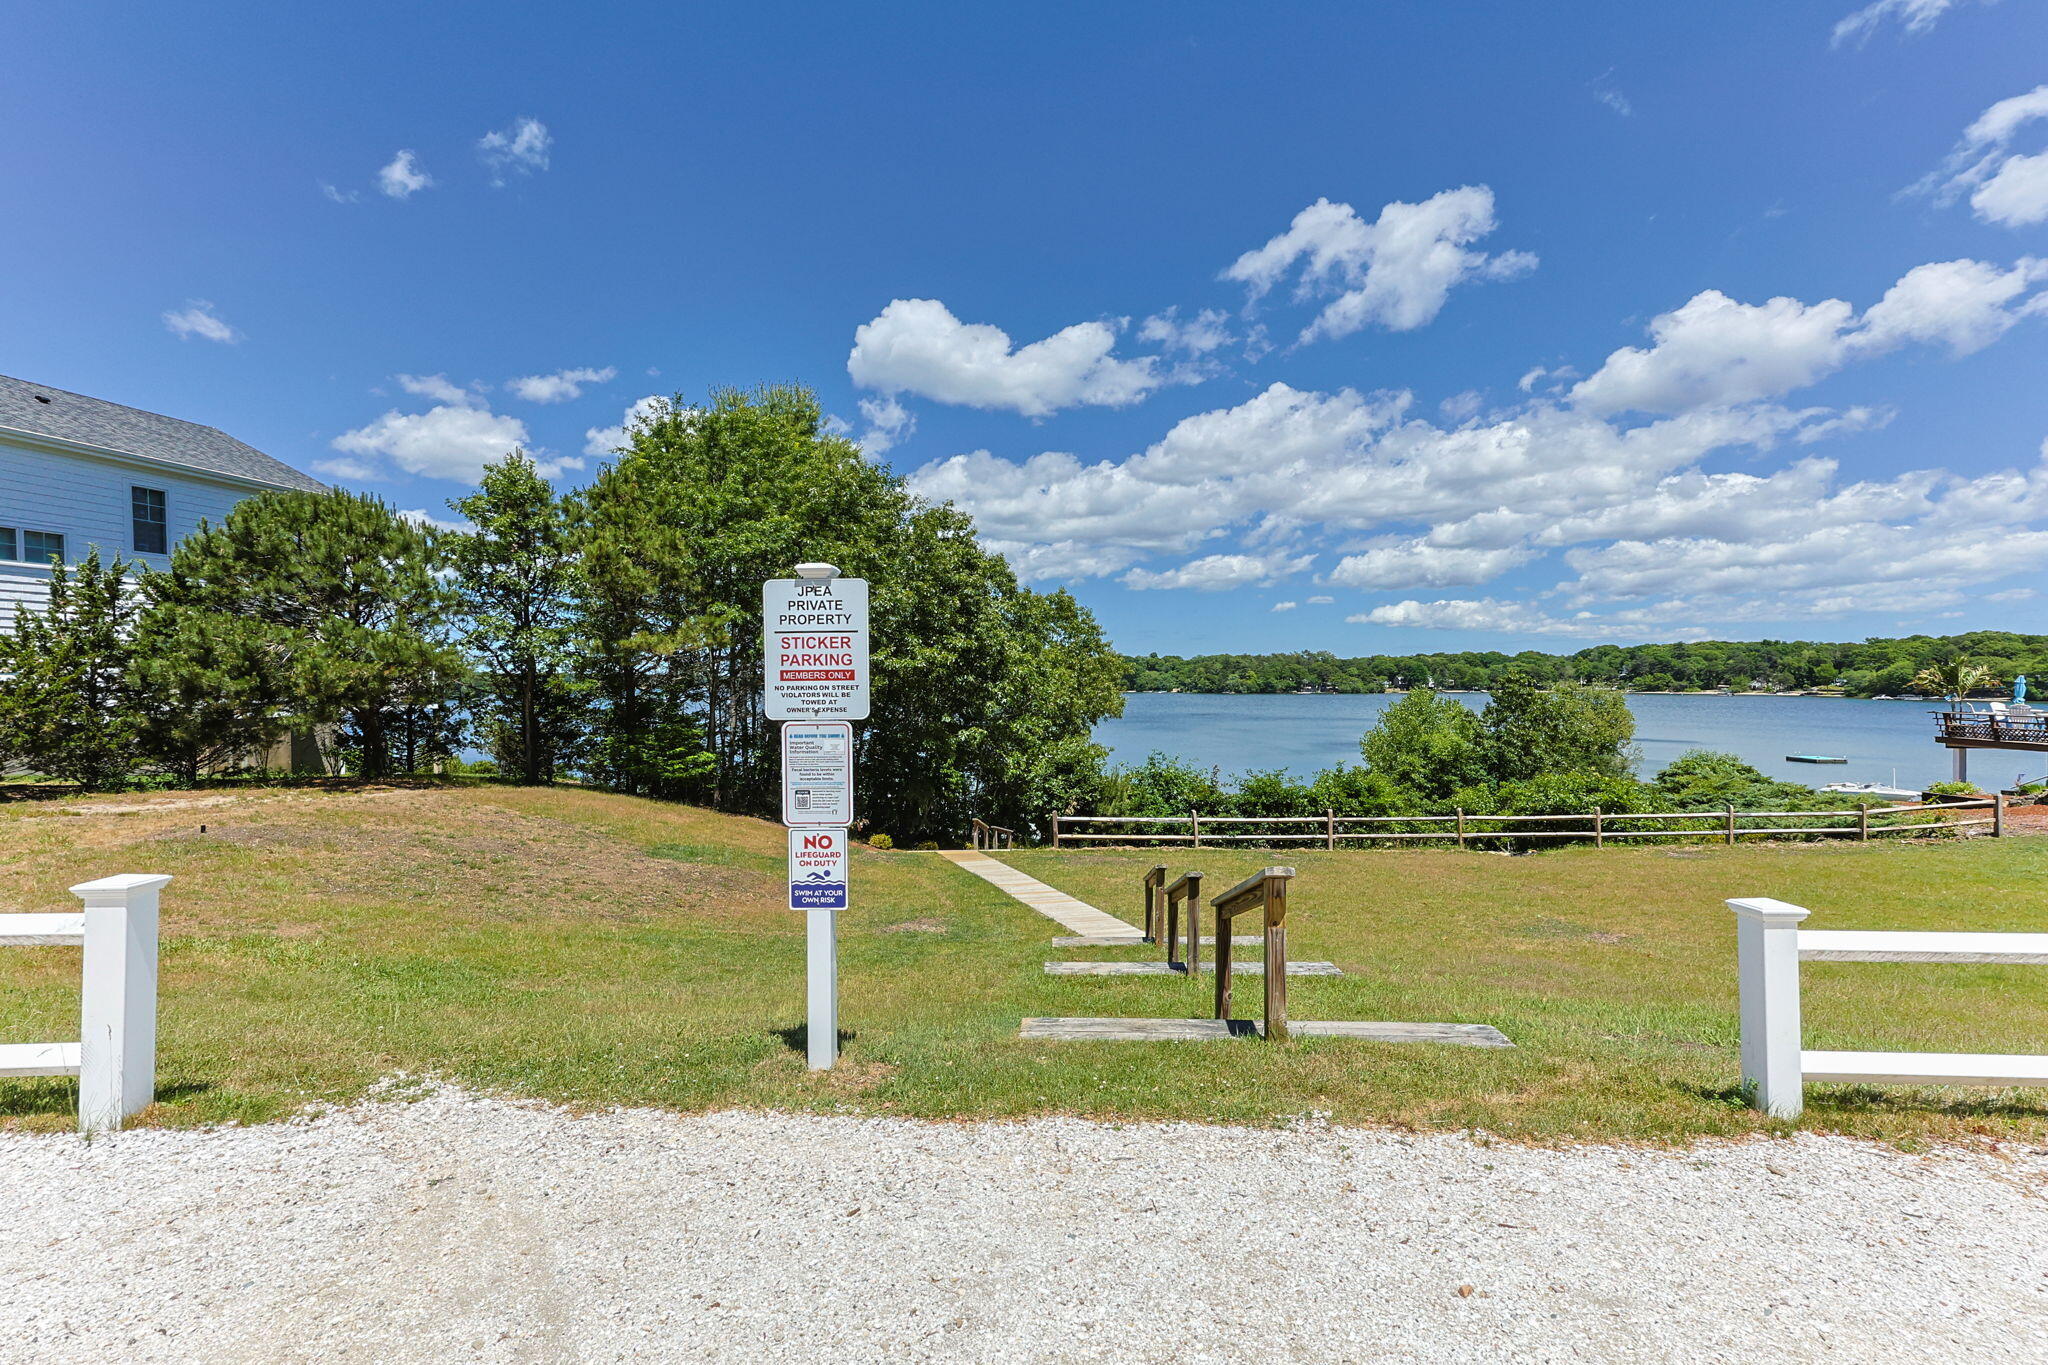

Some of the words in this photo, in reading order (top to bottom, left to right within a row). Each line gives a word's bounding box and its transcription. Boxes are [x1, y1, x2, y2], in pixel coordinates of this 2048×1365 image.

[798, 586, 832, 596] JPEA
[788, 600, 843, 610] PRIVATE
[780, 614, 852, 625] PROPERTY
[781, 637, 851, 649] STICKER
[781, 654, 853, 666] PARKING
[804, 835, 832, 849] NO
